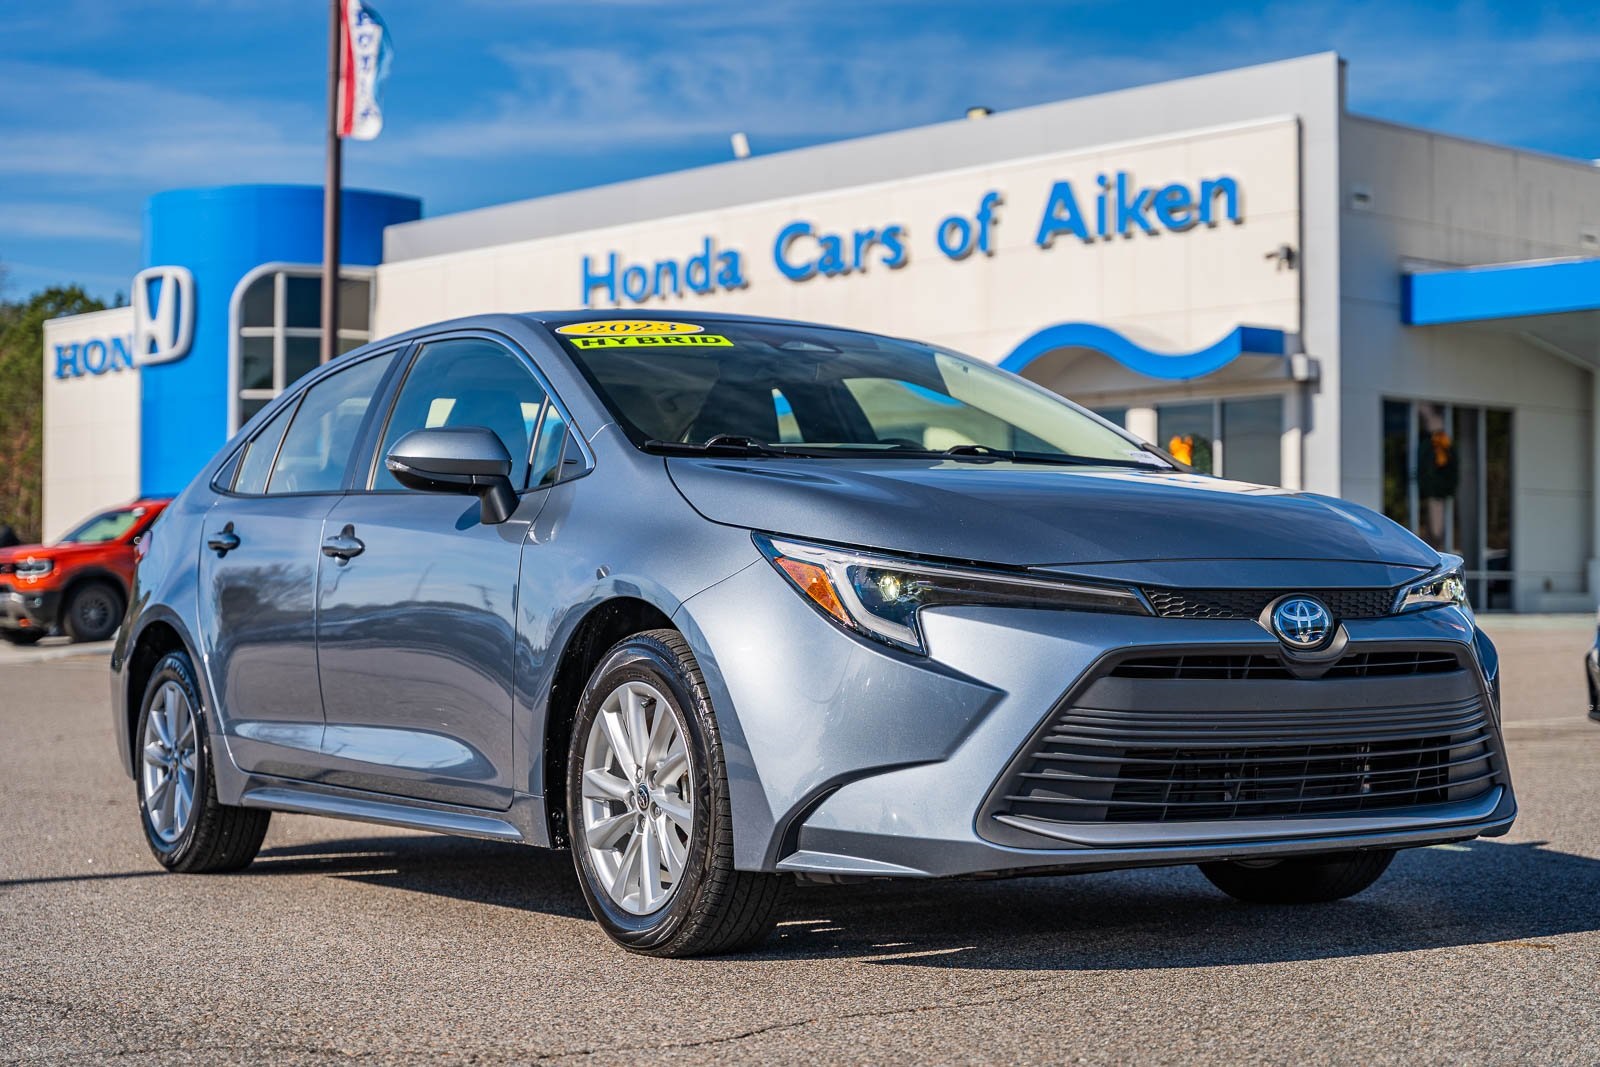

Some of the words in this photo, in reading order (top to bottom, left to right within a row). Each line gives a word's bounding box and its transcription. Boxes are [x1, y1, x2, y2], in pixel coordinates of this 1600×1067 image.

[582, 237, 743, 305] Honda
[773, 220, 907, 281] Cars
[936, 191, 1000, 258] of
[1036, 172, 1239, 246] Aiken
[581, 336, 722, 347] HYBRID
[588, 323, 678, 334] 2023
[54, 332, 135, 379] HON
